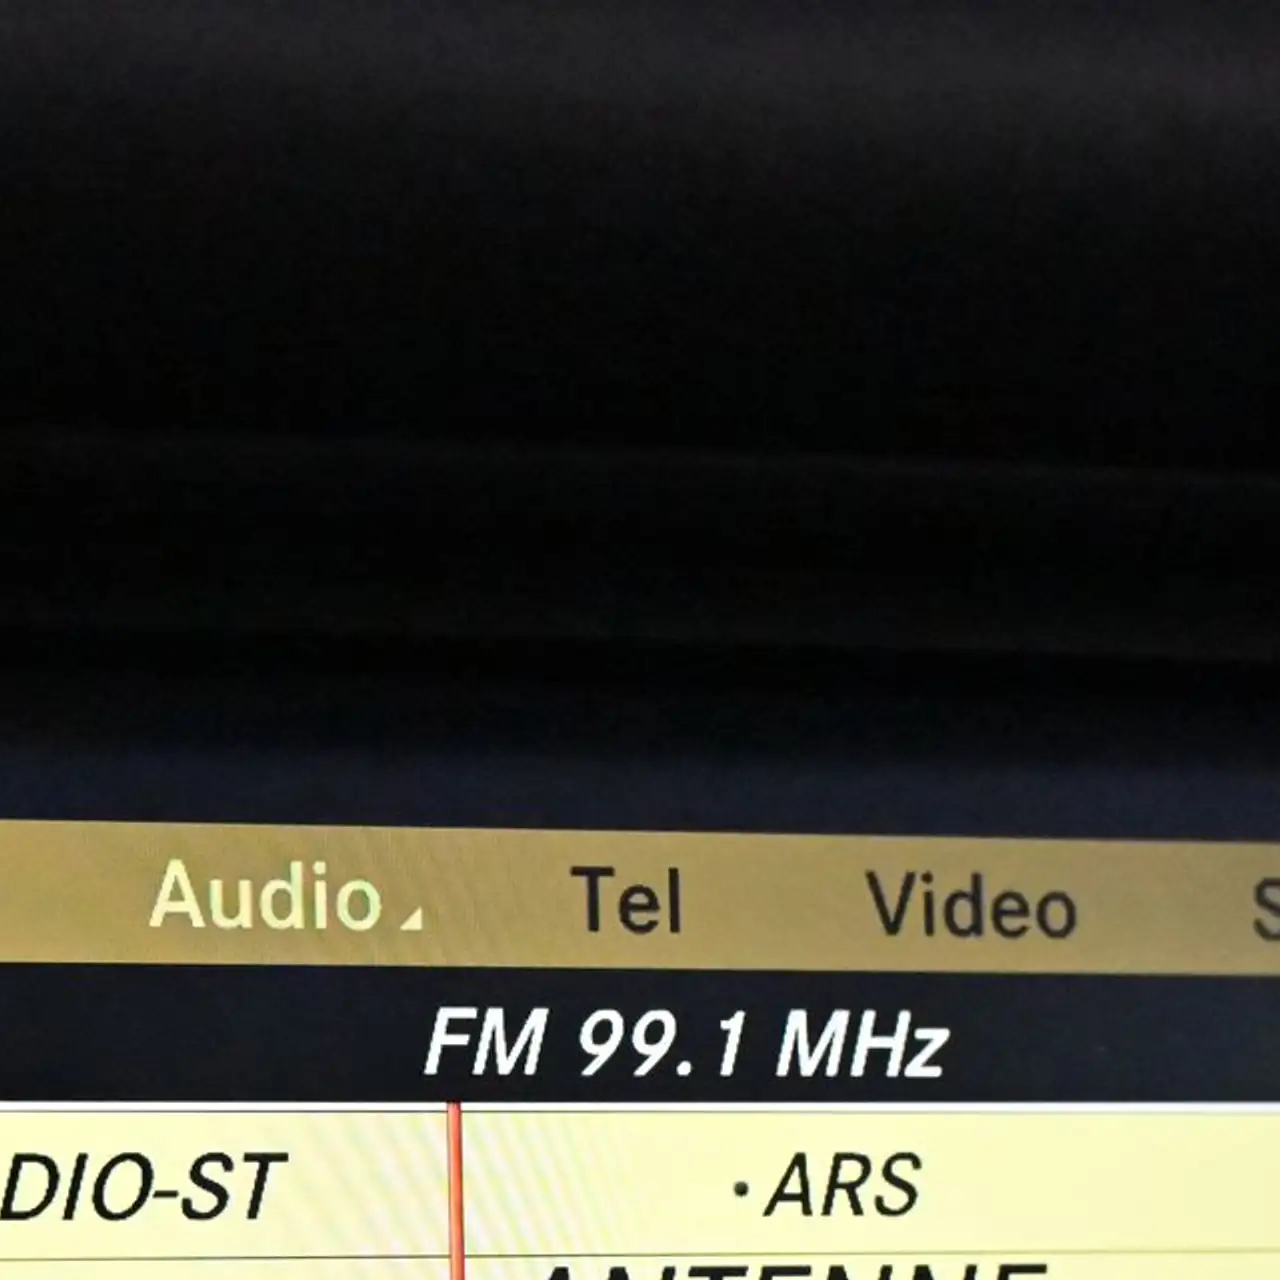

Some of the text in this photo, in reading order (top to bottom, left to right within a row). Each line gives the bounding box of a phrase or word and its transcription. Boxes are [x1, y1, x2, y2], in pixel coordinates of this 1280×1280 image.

[148, 858, 382, 931] Audio
[569, 865, 682, 935] Tel
[865, 870, 1078, 940] Video
[424, 1006, 951, 1078] FM 99.1 MHz
[762, 1151, 922, 1217] ARS
